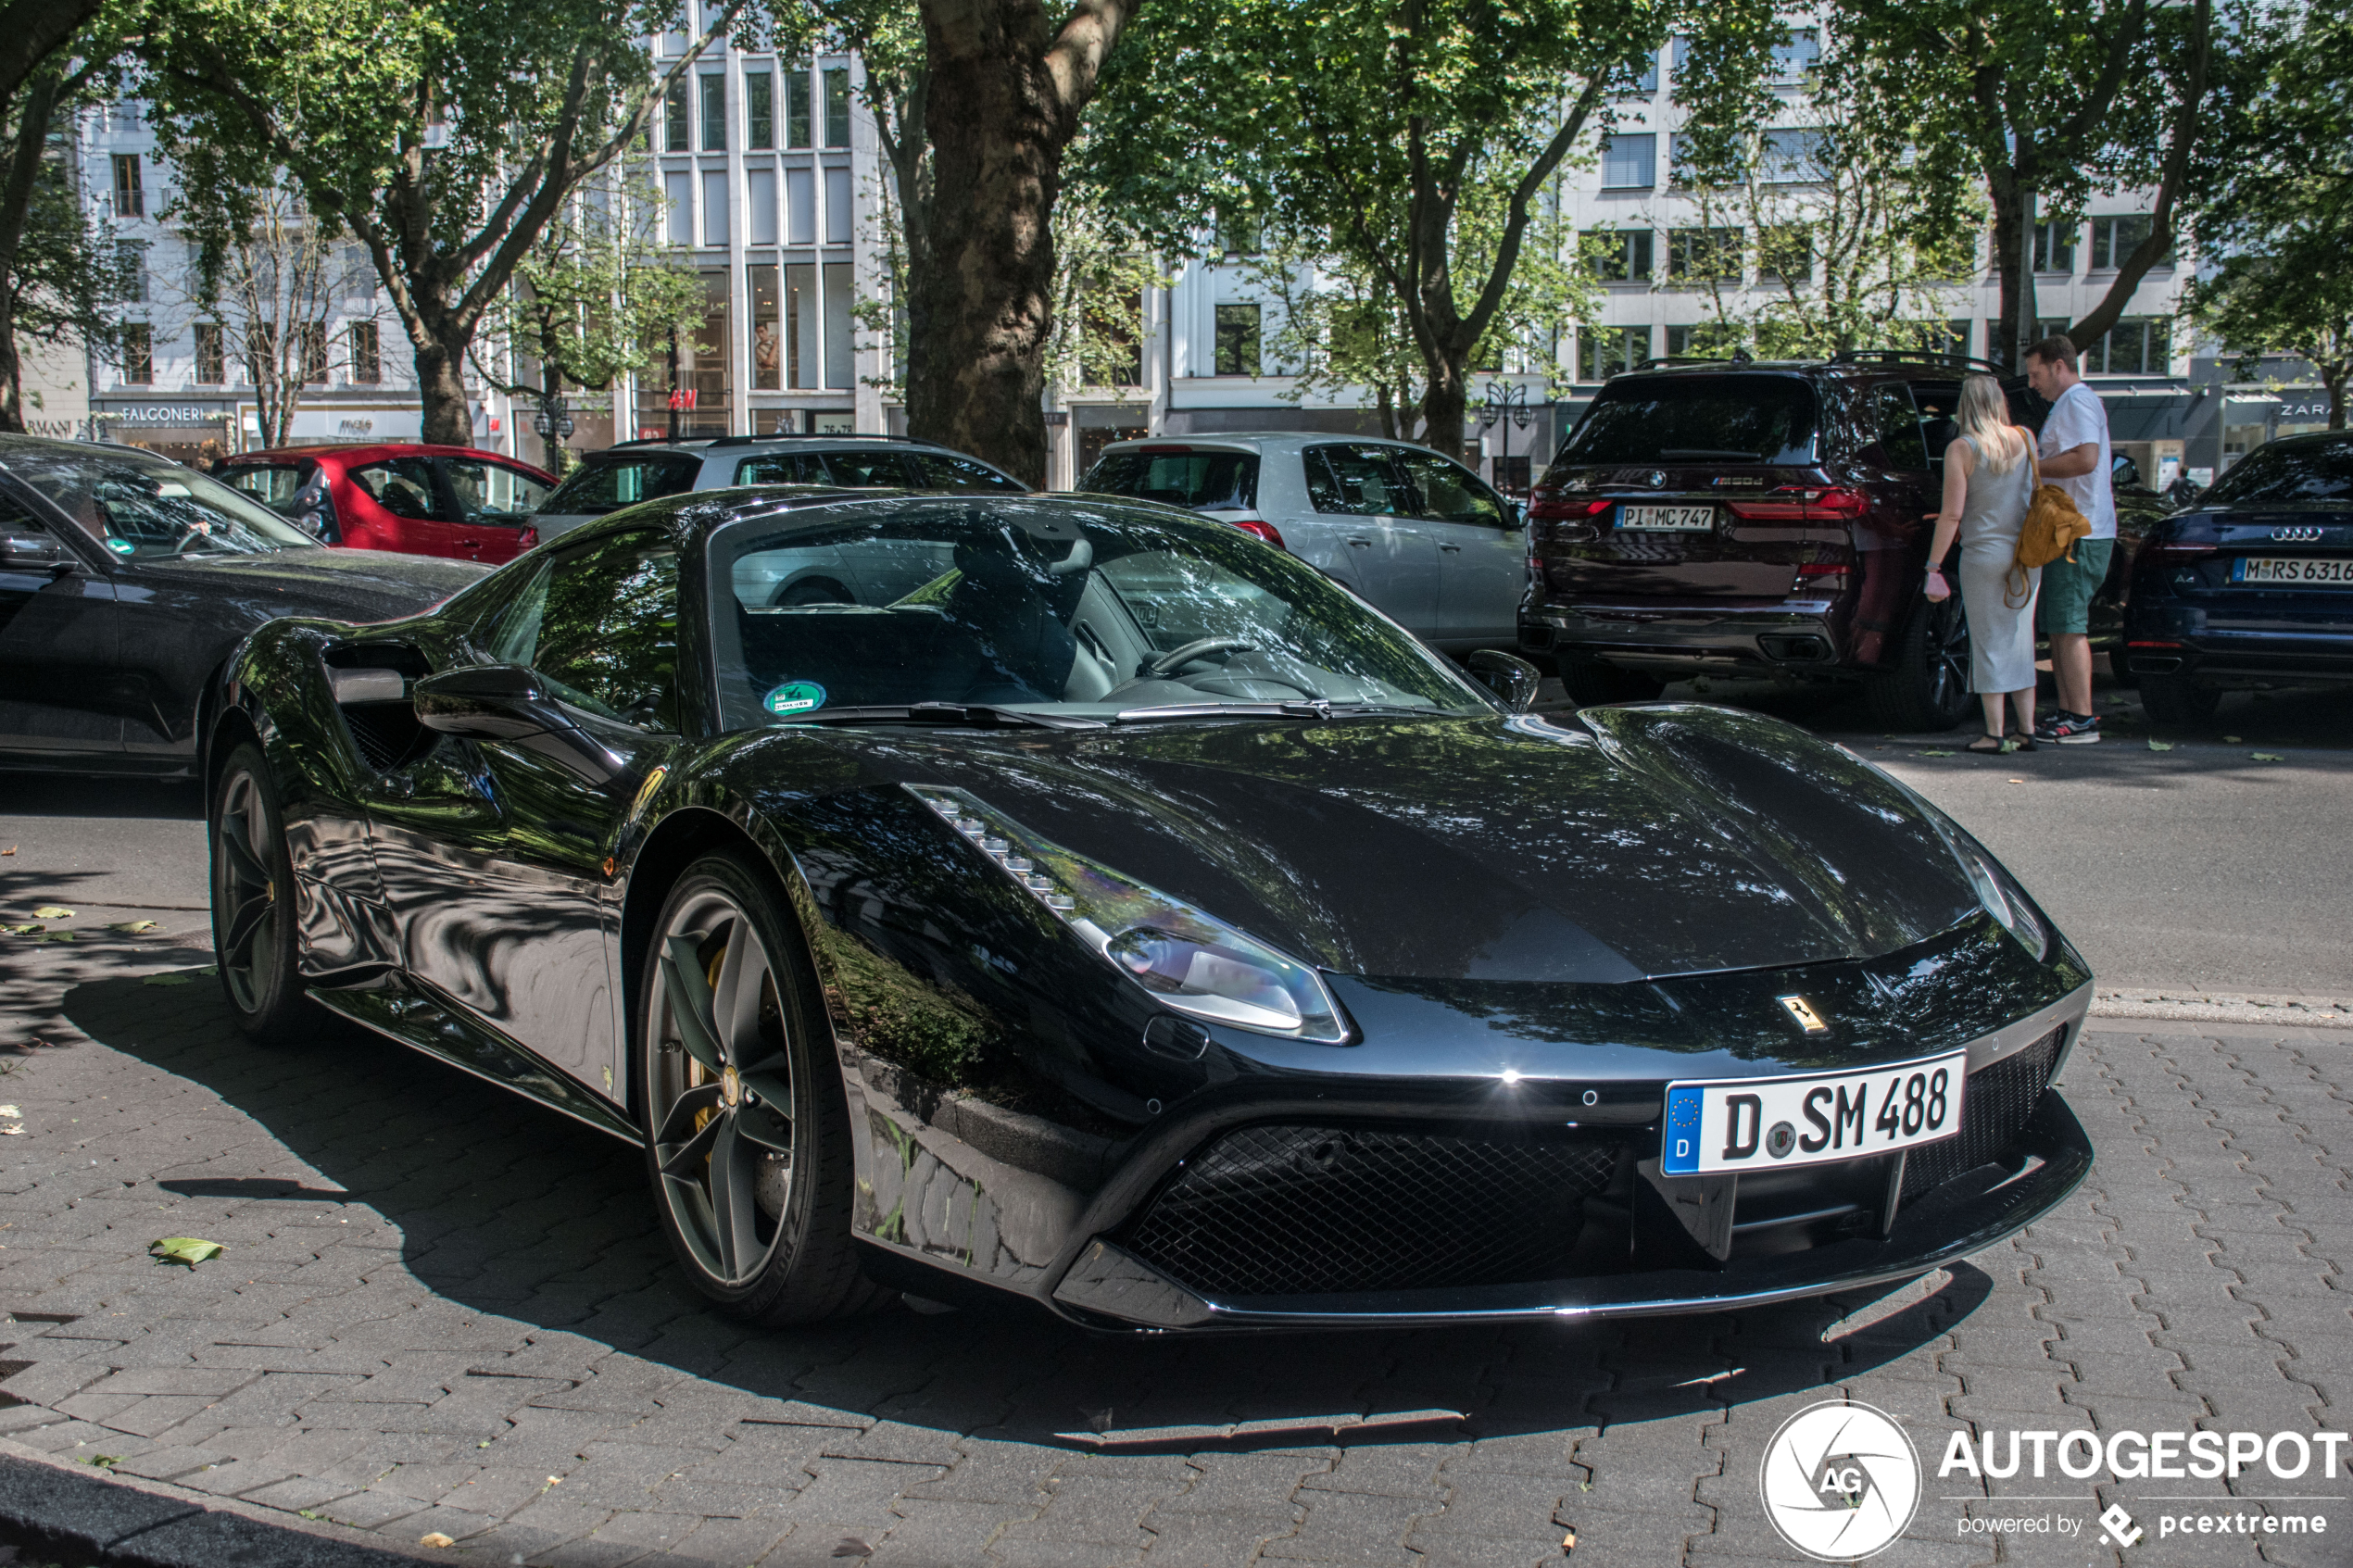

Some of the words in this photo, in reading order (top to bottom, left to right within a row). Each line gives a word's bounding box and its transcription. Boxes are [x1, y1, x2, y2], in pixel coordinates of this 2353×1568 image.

[668, 389, 698, 409] H&M
[122, 408, 204, 420] FALCONERI
[28, 420, 71, 433] RMANI
[1624, 509, 1642, 525] PI
[1655, 509, 1676, 526] MC
[1680, 509, 1711, 526] 747
[2246, 560, 2260, 579] M
[2272, 561, 2299, 579] RS
[2304, 561, 2353, 581] 6316
[787, 686, 803, 699] 4
[1675, 1138, 1690, 1158] D
[1721, 1093, 1762, 1160] D
[1799, 1082, 1867, 1153] SM
[1874, 1067, 1948, 1140] 488
